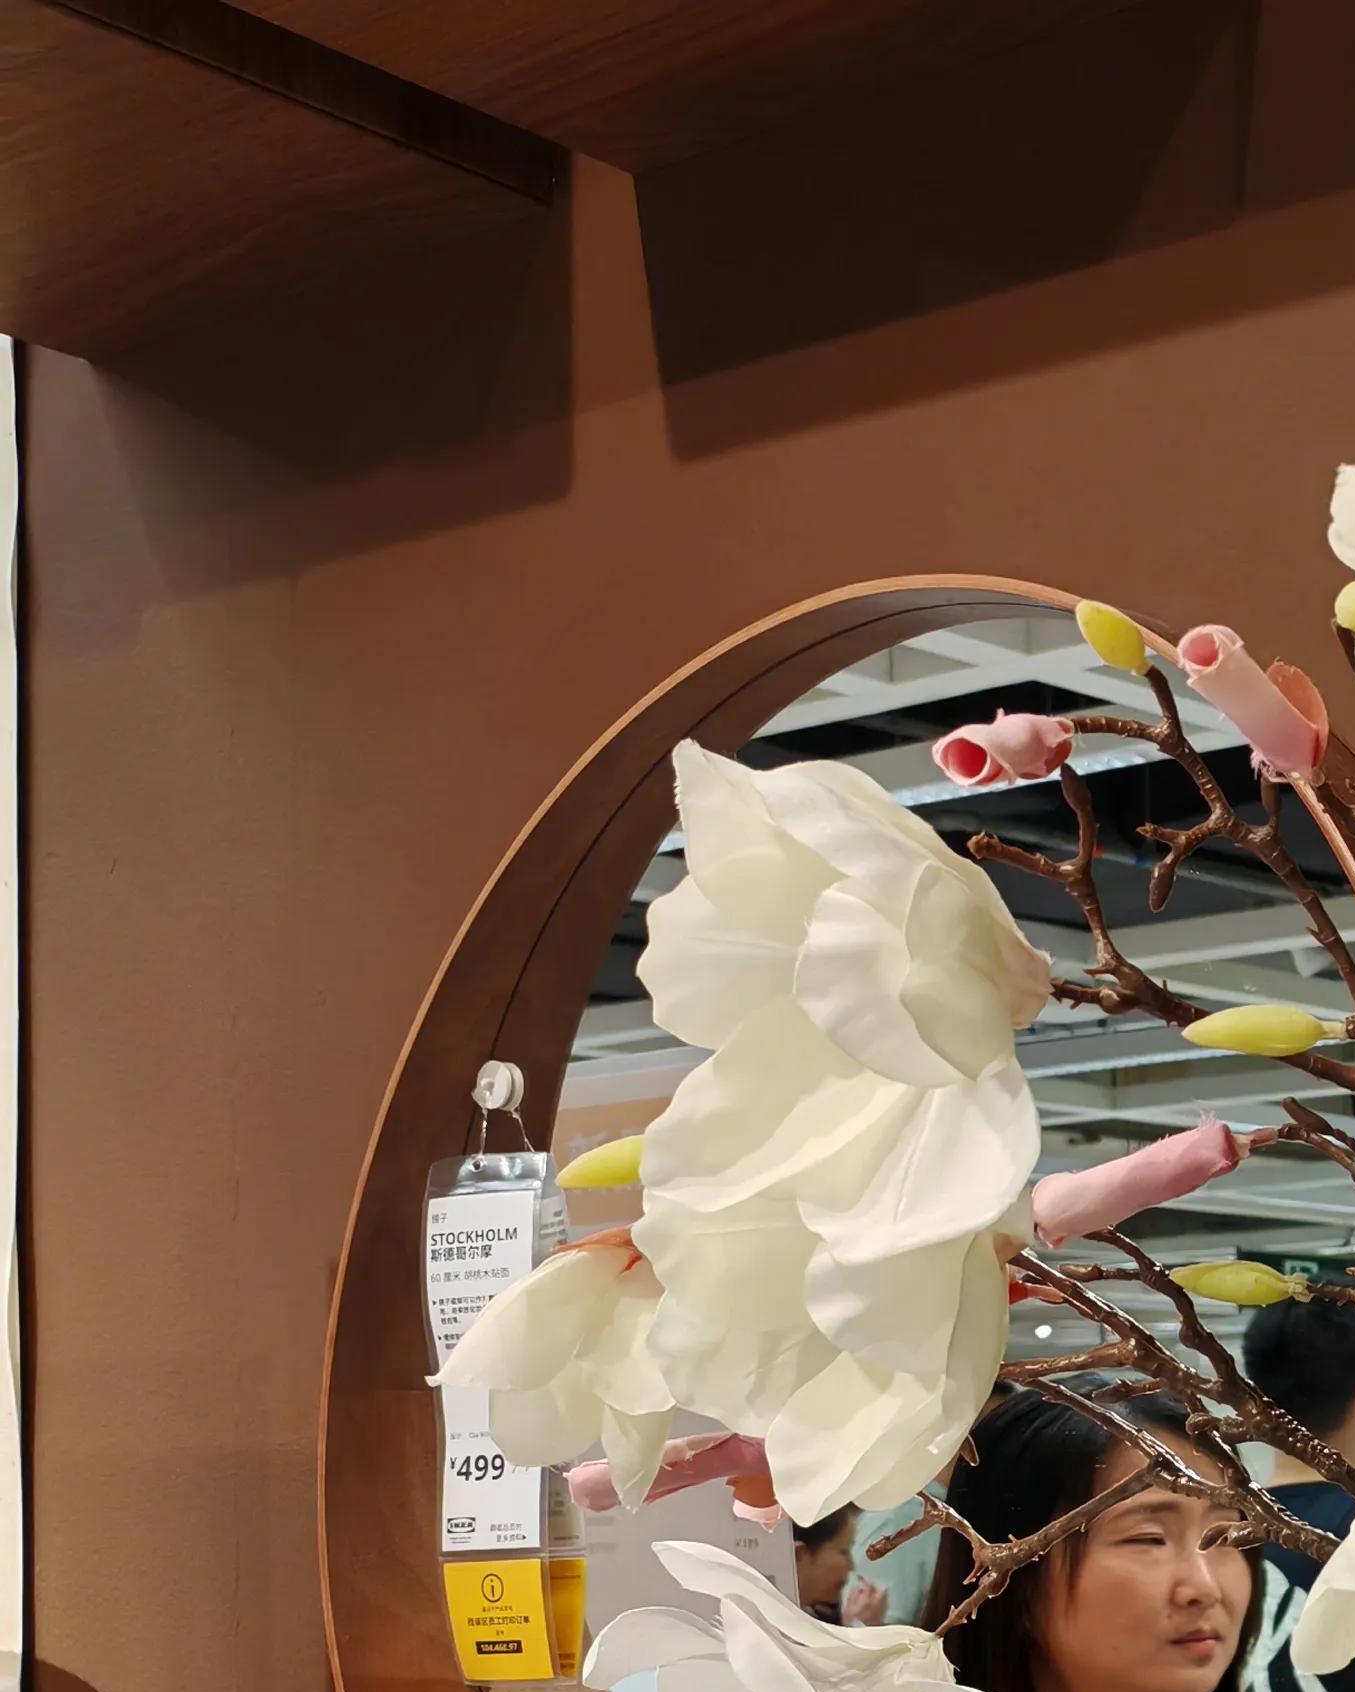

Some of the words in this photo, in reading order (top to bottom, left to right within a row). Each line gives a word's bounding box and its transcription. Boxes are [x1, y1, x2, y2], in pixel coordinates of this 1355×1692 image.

[431, 1227, 518, 1246] STOCKHOLM
[431, 1244, 493, 1262] 斯德哥尔摩
